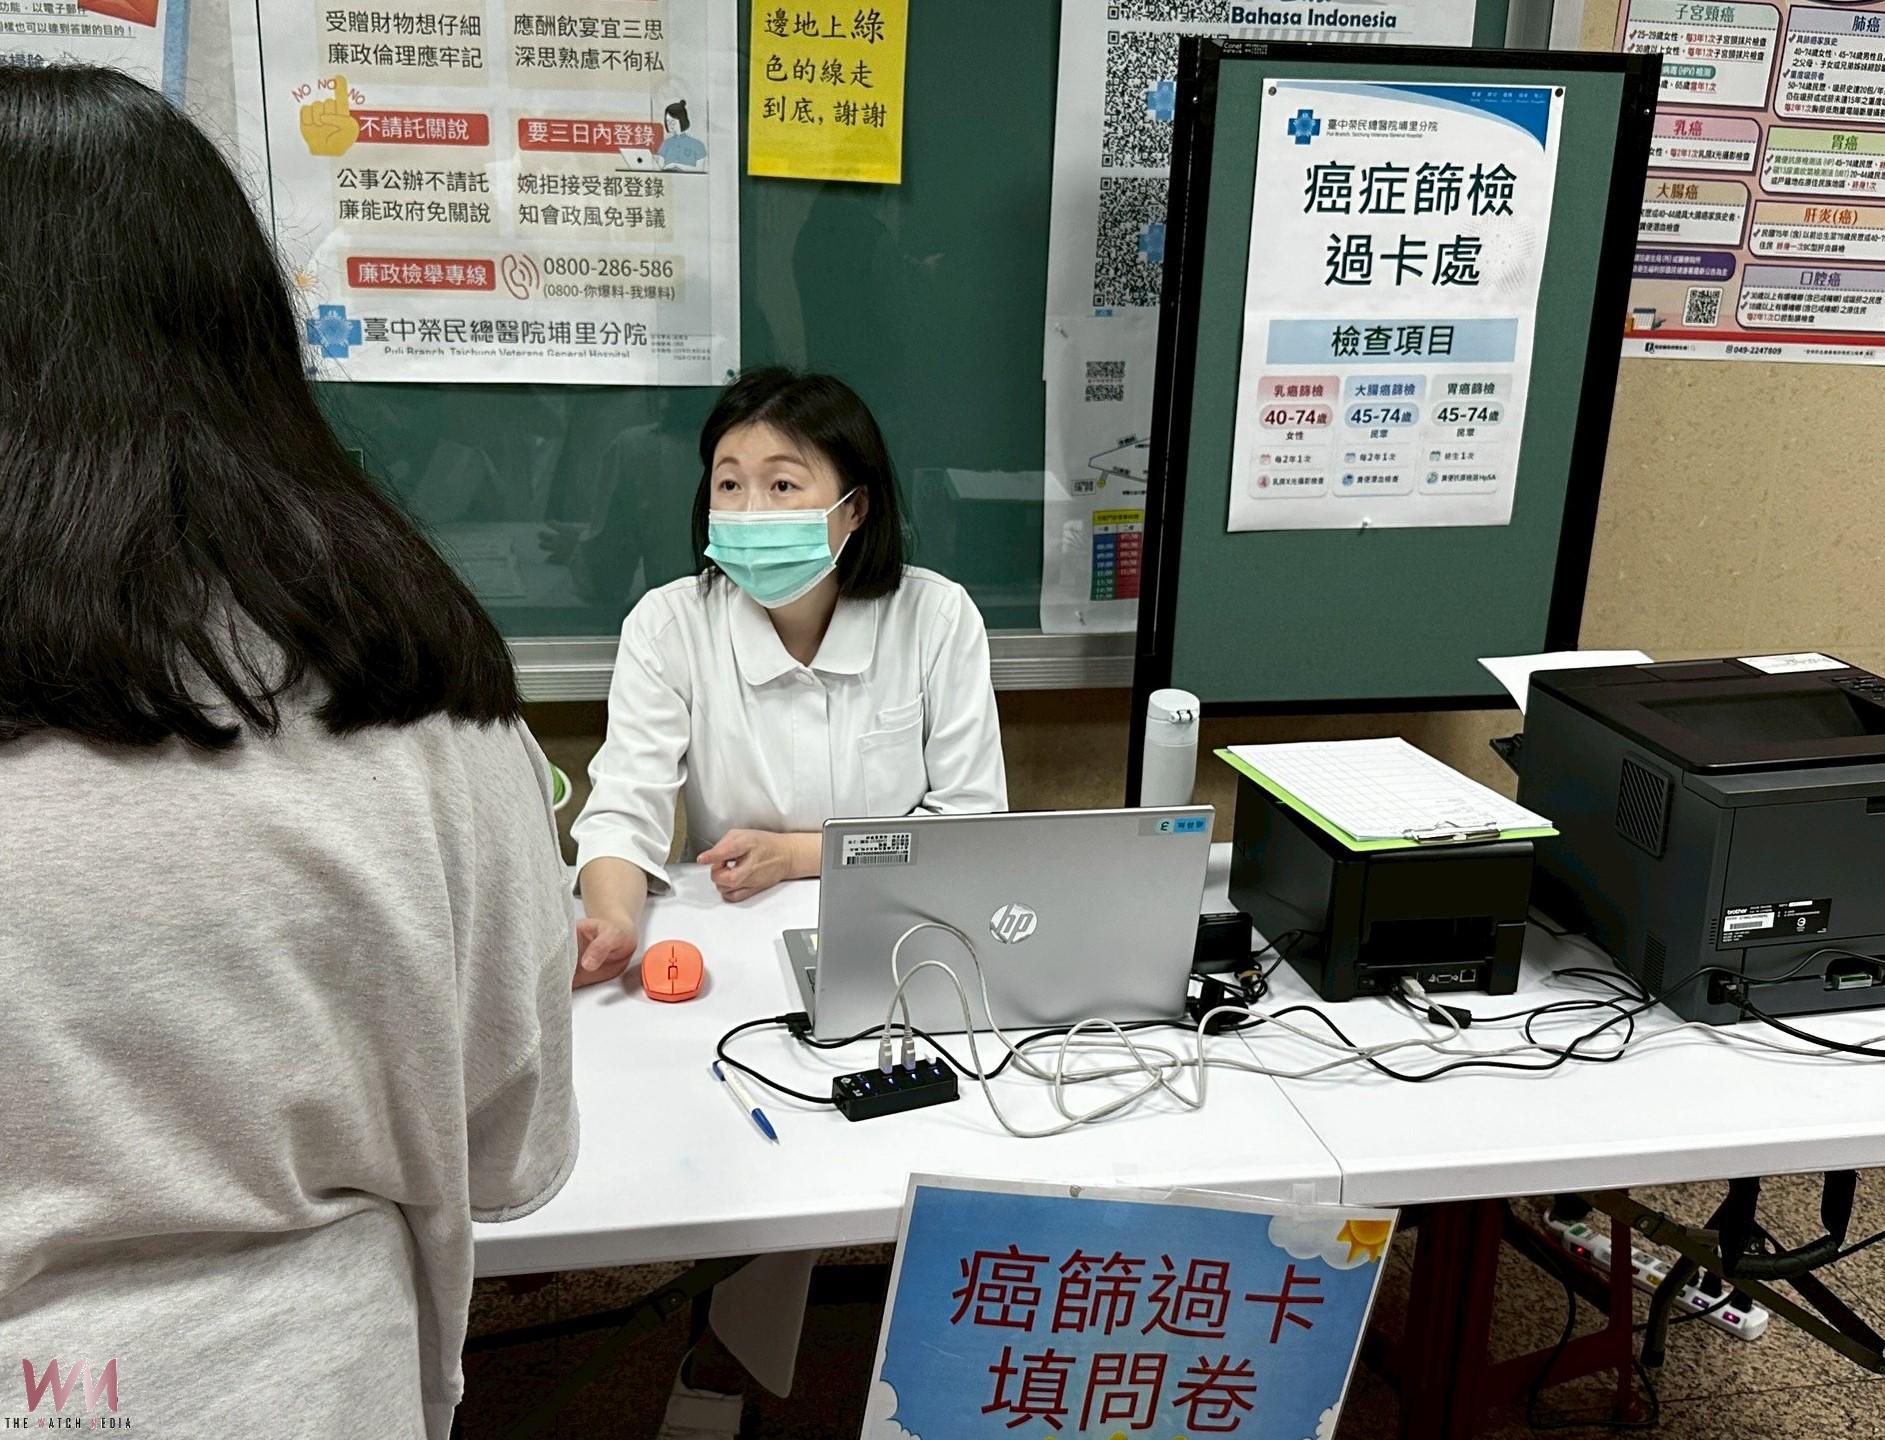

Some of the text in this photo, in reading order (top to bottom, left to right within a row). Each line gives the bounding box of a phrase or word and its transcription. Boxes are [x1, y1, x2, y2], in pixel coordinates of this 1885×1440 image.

[326, 10, 481, 37] 受贈財物想仔細
[764, 7, 885, 44] 邊地上綠
[1230, 7, 1397, 29] Bahasa Indonesia
[1675, 3, 1736, 23] 子宮頸癌
[1851, 15, 1881, 32] 肺癌
[513, 13, 664, 41] 應酬飲宴宜三思
[328, 42, 483, 69] 廉政倫理應牢記
[515, 45, 665, 72] 深思熟慮不徇私
[765, 54, 874, 88] 色的線走
[292, 79, 366, 105] NO NO NO
[360, 116, 469, 141] 不請託關說
[527, 121, 655, 147] 要三日內登錄
[1673, 119, 1704, 136] 乳癌
[1831, 134, 1858, 151] 胃癌
[337, 168, 490, 193] 公事公辦不請託
[517, 173, 664, 198] 婉拒接受都登錄
[1303, 160, 1517, 216] 癌症篩檢
[1656, 182, 1700, 200] 大腸癌
[339, 199, 491, 224] 廉能政府免關說
[518, 204, 667, 229] 知會政風免爭議
[1803, 207, 1858, 225] 肝炎(癌)
[543, 257, 674, 278] 0800-286-586
[1324, 233, 1483, 287] 過卡處
[358, 262, 488, 286] 廉政檢舉專線
[1800, 271, 1841, 287] 口腔癌
[543, 284, 675, 302] (0800-你爆料-我爆料)
[363, 317, 648, 347] 臺中榮民總醫院埔里分院
[1331, 324, 1455, 358] 檢查項目
[1273, 385, 1324, 398] 乳癌篩檢
[1355, 383, 1416, 397] 大腸癌篩檢
[1447, 382, 1496, 396] 胃癌篩檢
[1264, 409, 1328, 425] 40-74歲
[1351, 408, 1412, 423] 45-74歲
[1437, 407, 1499, 422] 45-74歲
[1285, 431, 1304, 441] 女性
[992, 904, 1037, 944] hp
[950, 1243, 1325, 1344] 癌篩過卡
[981, 1345, 1258, 1432] 填問卷
